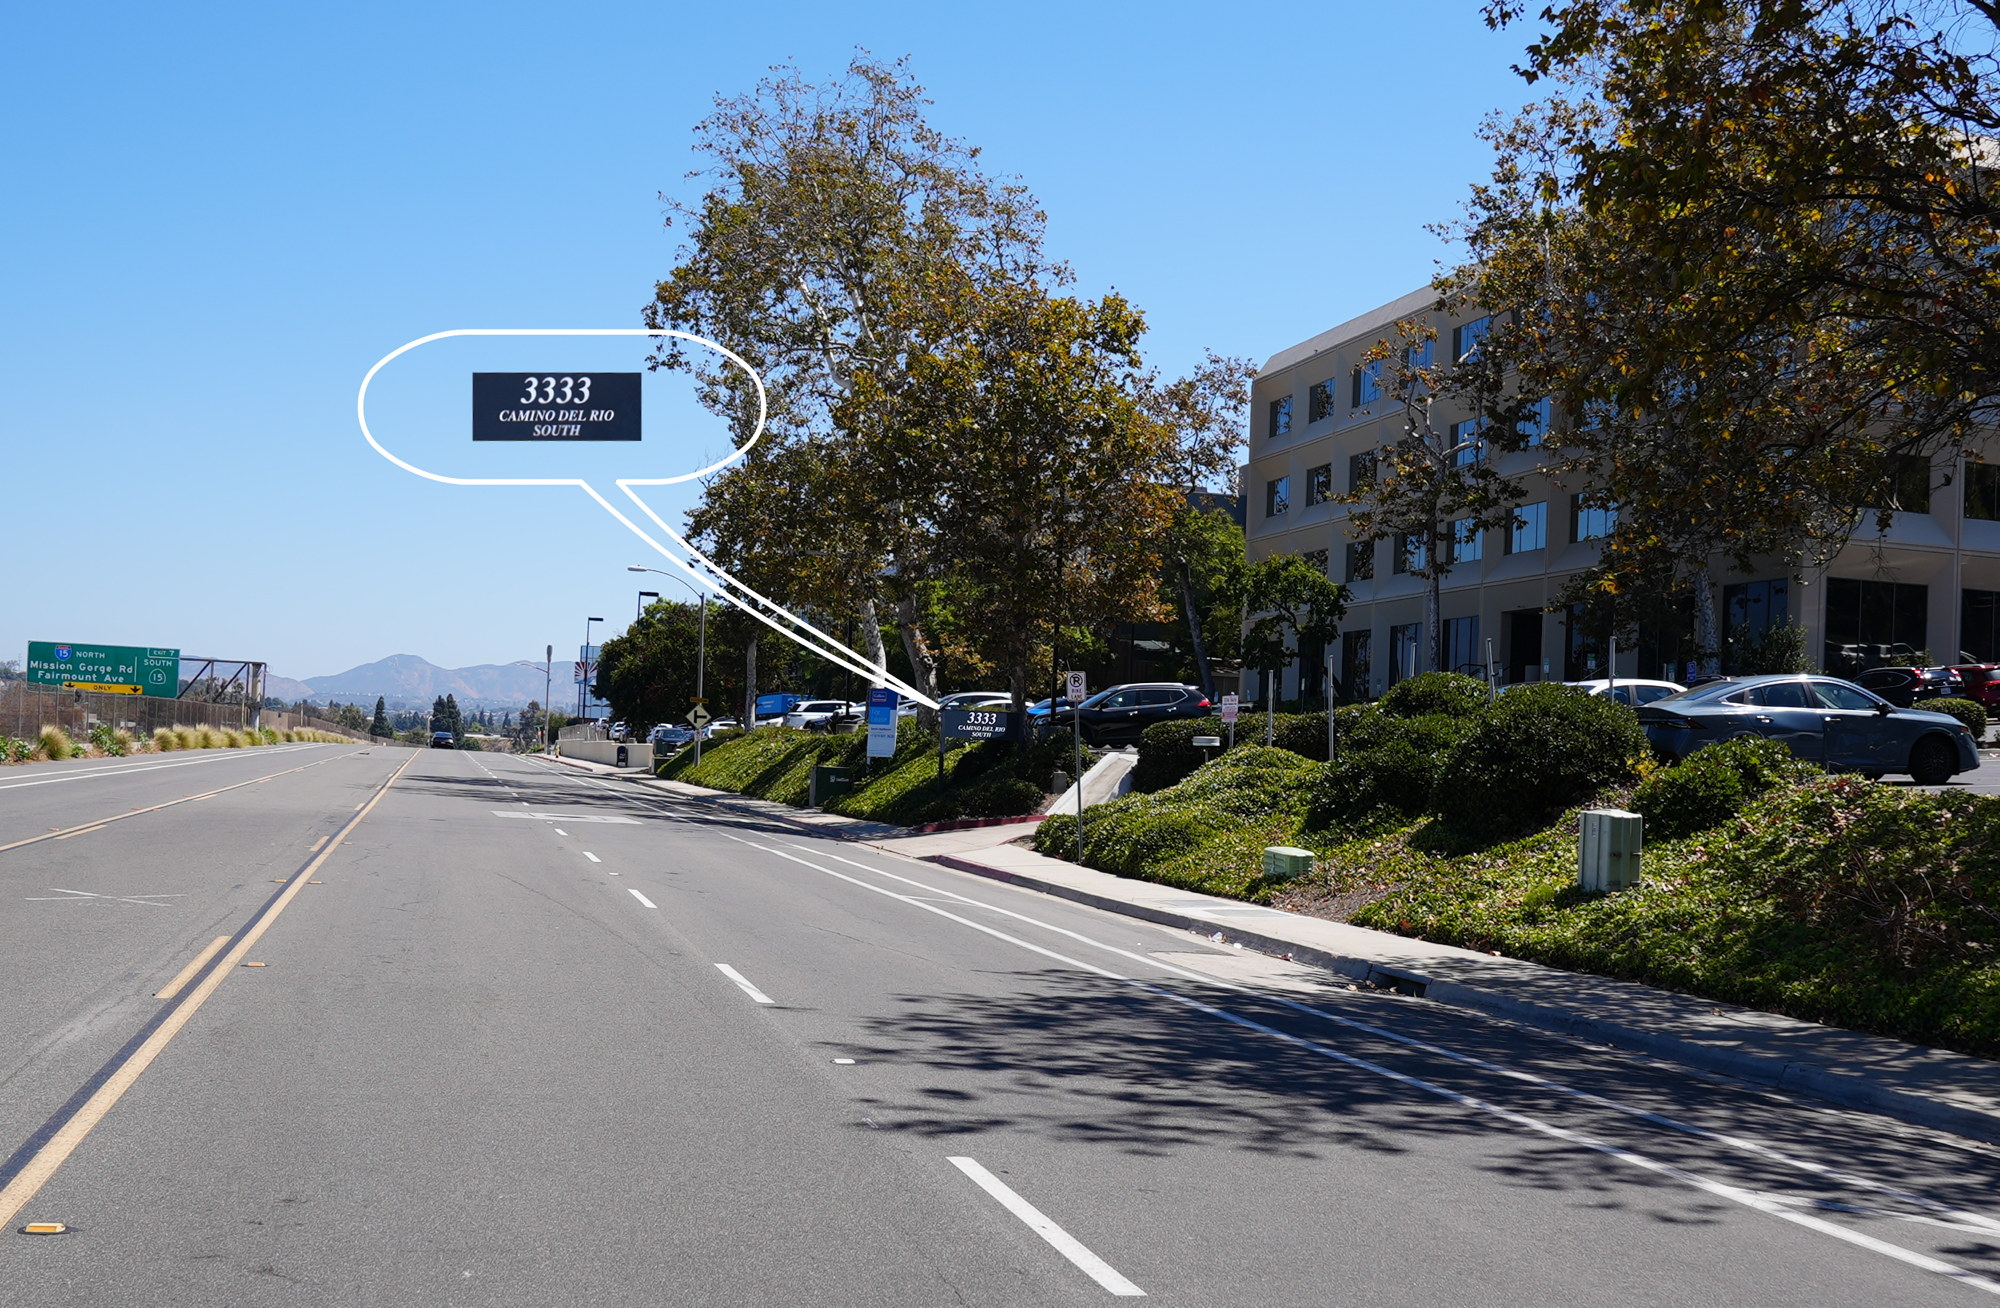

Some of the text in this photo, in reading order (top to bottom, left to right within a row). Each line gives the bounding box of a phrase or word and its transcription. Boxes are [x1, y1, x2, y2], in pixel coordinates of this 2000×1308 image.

[59, 650, 105, 659] 15 NORTH
[143, 658, 173, 667] SOUTH
[30, 660, 133, 675] Mission Gorge Rd
[37, 670, 124, 683] Fairmount Ave
[153, 673, 163, 682] 15
[967, 711, 997, 725] 3333
[957, 724, 982, 732] CAMINO
